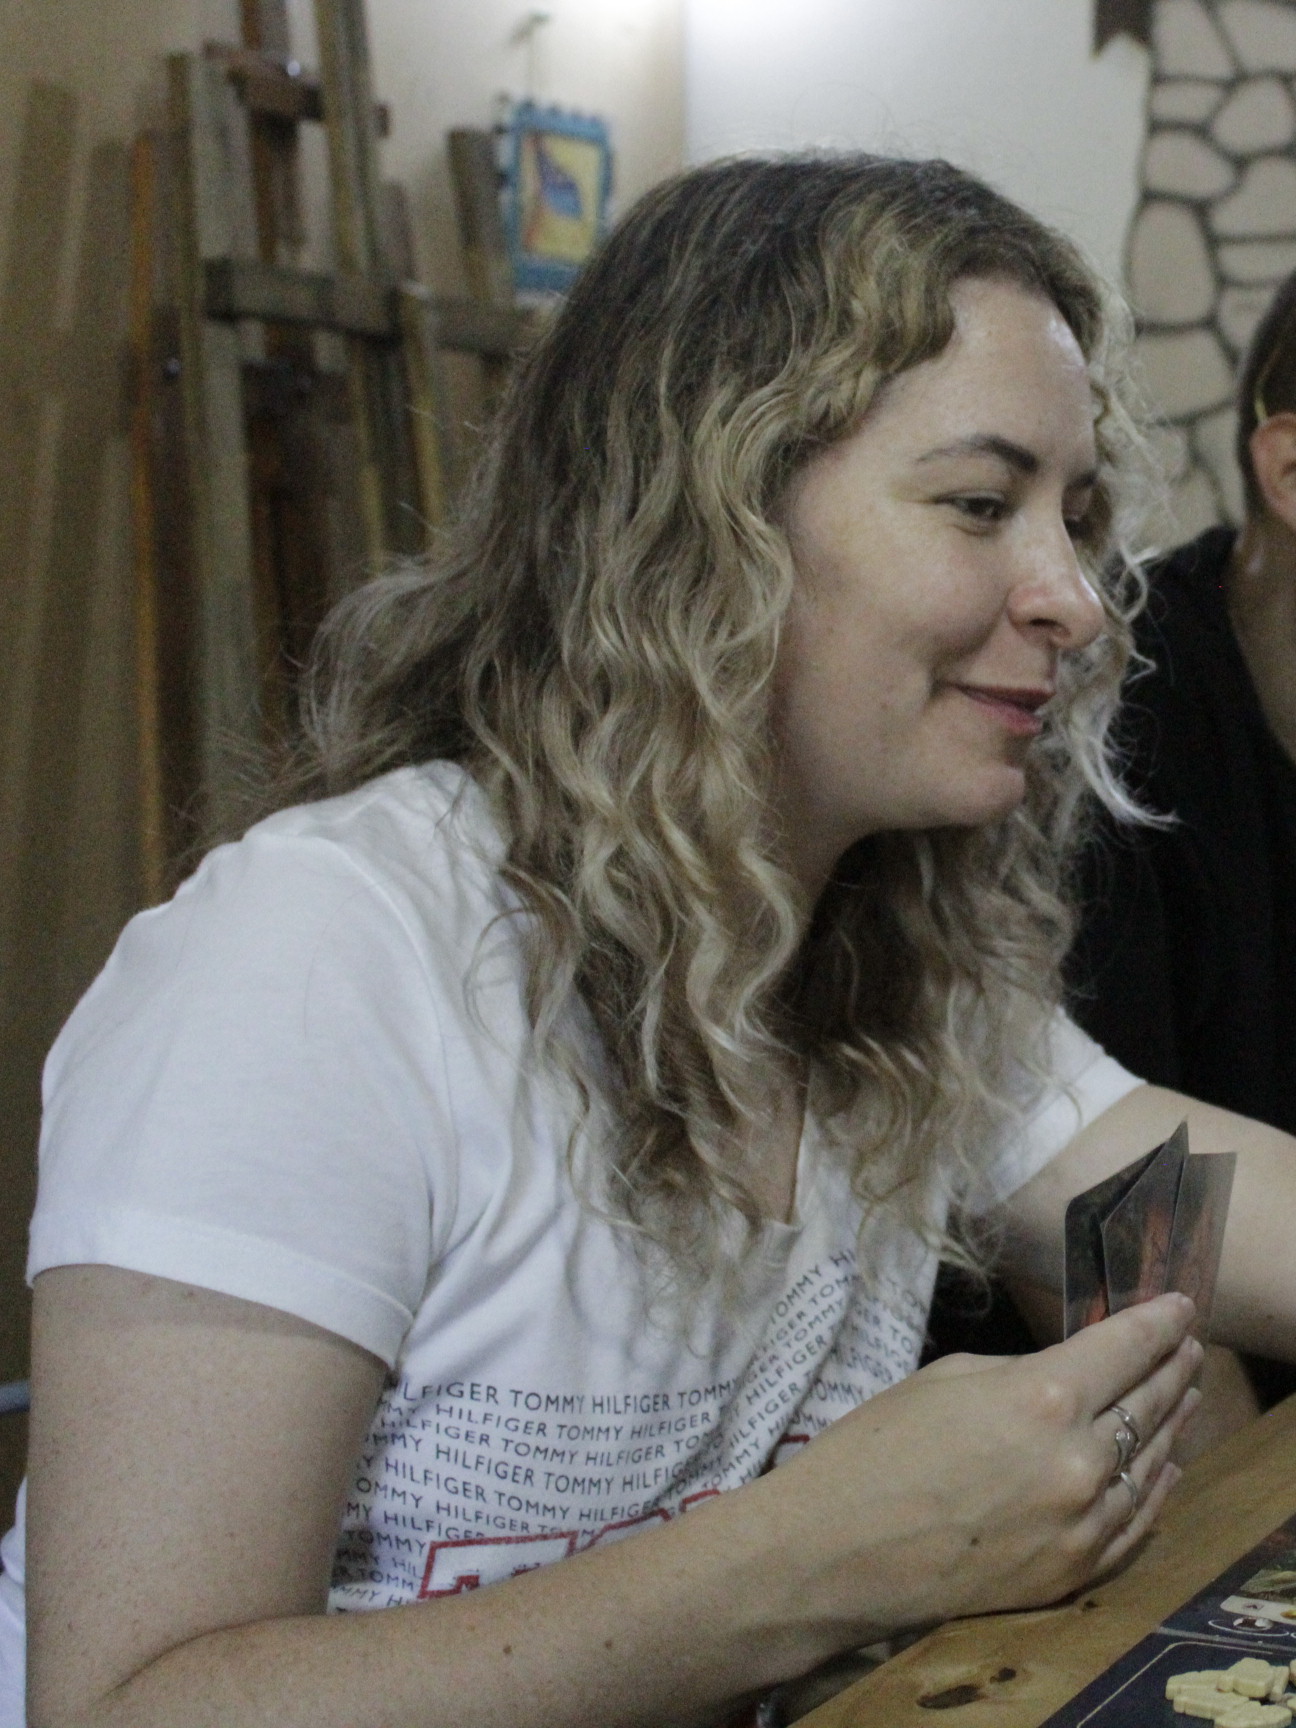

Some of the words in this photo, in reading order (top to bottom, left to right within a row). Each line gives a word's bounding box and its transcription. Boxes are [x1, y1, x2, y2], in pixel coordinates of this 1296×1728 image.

[403, 1382, 499, 1405] LFIGER
[509, 1389, 585, 1414] TOMMY
[592, 1394, 671, 1415] HILFIGER
[436, 1403, 547, 1437] HILFIGER
[556, 1423, 624, 1442] TOMMY
[630, 1411, 712, 1440] HILFIGER
[746, 1334, 828, 1405] HILFIGER
[435, 1443, 535, 1488] HILFIGER
[543, 1471, 615, 1496] TOMMY
[501, 1437, 578, 1465] TOMMY
[585, 1444, 666, 1467] HILFIGER
[702, 1440, 760, 1489] TOMMY
[356, 1478, 424, 1509] OMMY
[436, 1500, 530, 1534] HILFIGER
[385, 1456, 487, 1503] HILFIGER
[493, 1490, 570, 1521] TOMMY
[344, 1529, 427, 1556] TOMMY
